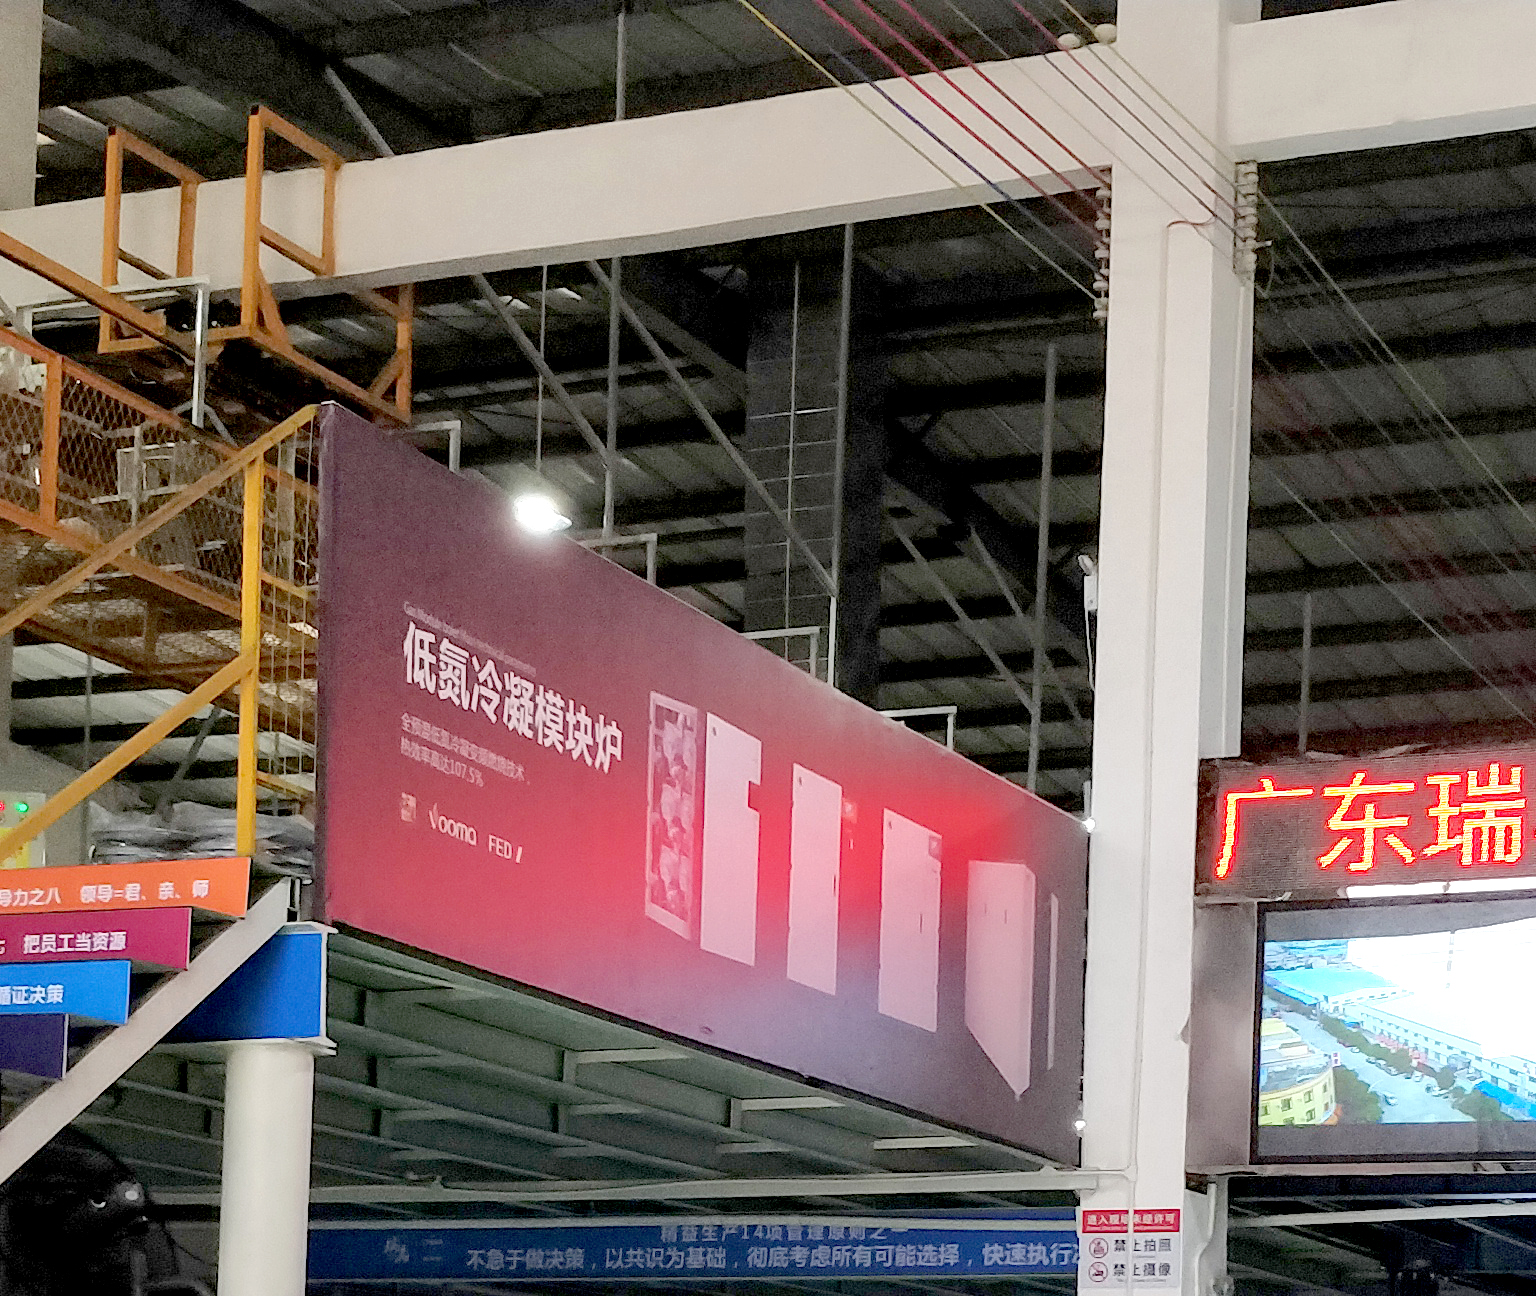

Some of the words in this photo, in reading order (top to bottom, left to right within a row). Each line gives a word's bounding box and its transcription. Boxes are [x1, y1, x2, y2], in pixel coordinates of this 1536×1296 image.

[402, 621, 624, 774] 低氮冷凝模块炉
[24, 931, 127, 955] 把员工当资源
[466, 1243, 1080, 1271] 不急于做决策，以共识为基础，彻底考虑所有可能选择，快速执行
